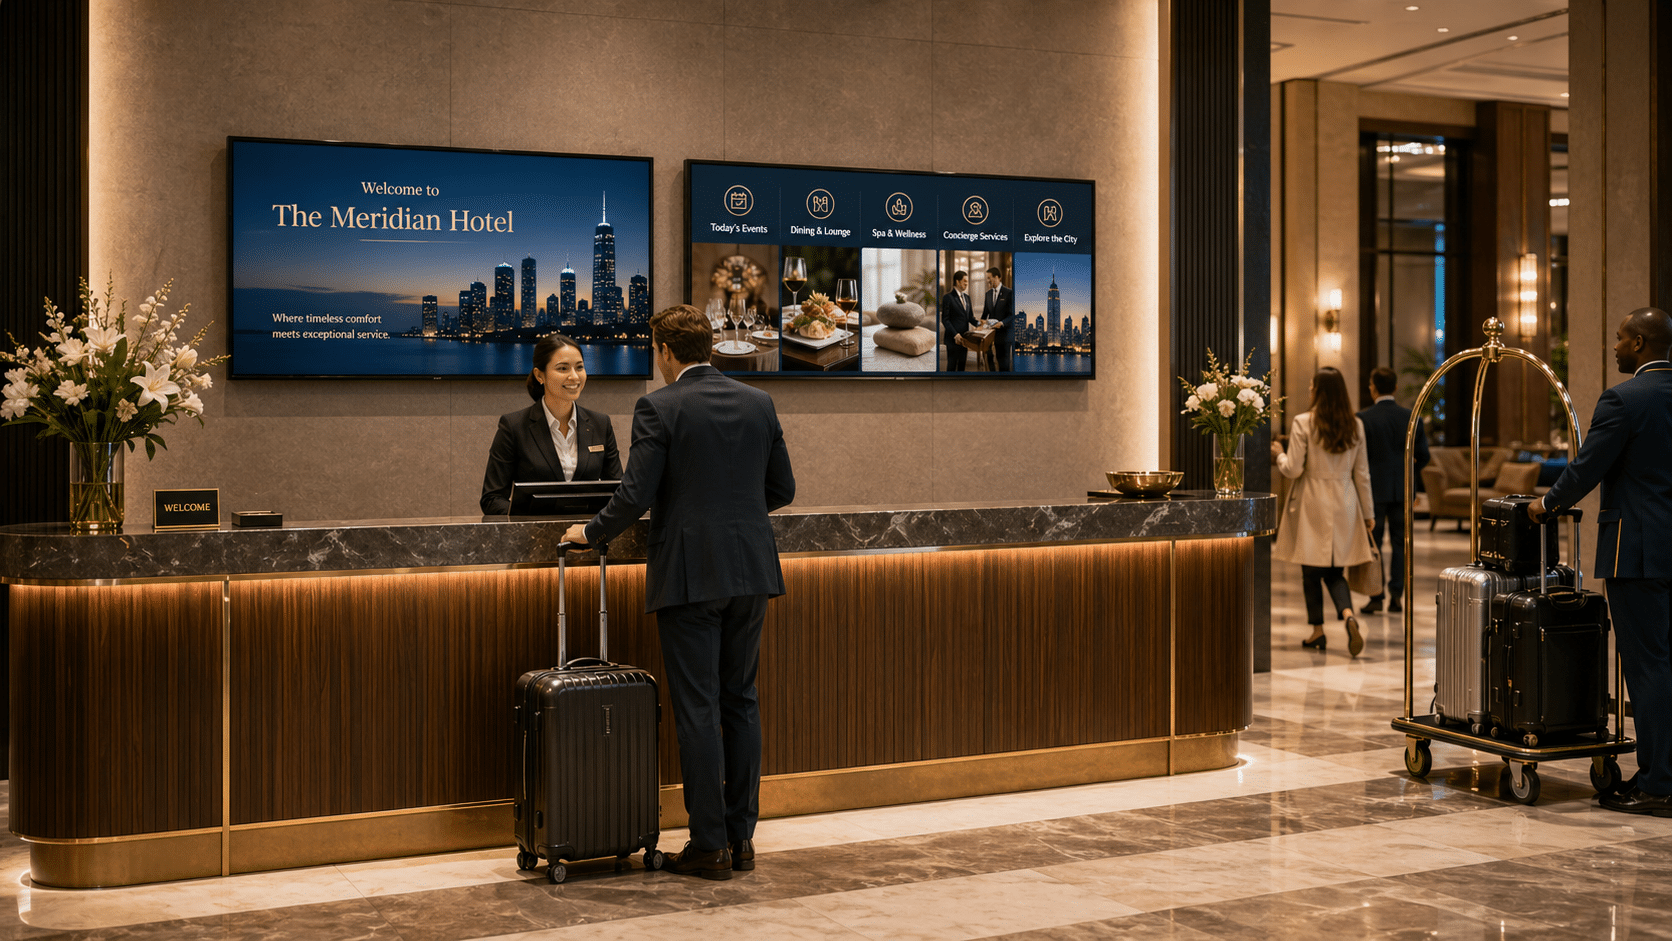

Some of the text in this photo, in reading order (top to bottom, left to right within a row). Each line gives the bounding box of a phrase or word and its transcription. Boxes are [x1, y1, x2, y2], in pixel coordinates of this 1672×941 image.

[361, 181, 439, 197] Welcome to
[272, 203, 514, 232] The Meridian Hotel
[710, 222, 768, 234] Today's Events
[790, 225, 851, 238] Dining & Lounge
[872, 228, 927, 239] Spa & Wellness
[943, 231, 1009, 242] Concierge Services
[1024, 233, 1078, 245] Explore the City
[272, 313, 382, 324] Where timeless comfort
[272, 329, 391, 341] meets exceptional service.
[164, 502, 211, 512] WELCOME
